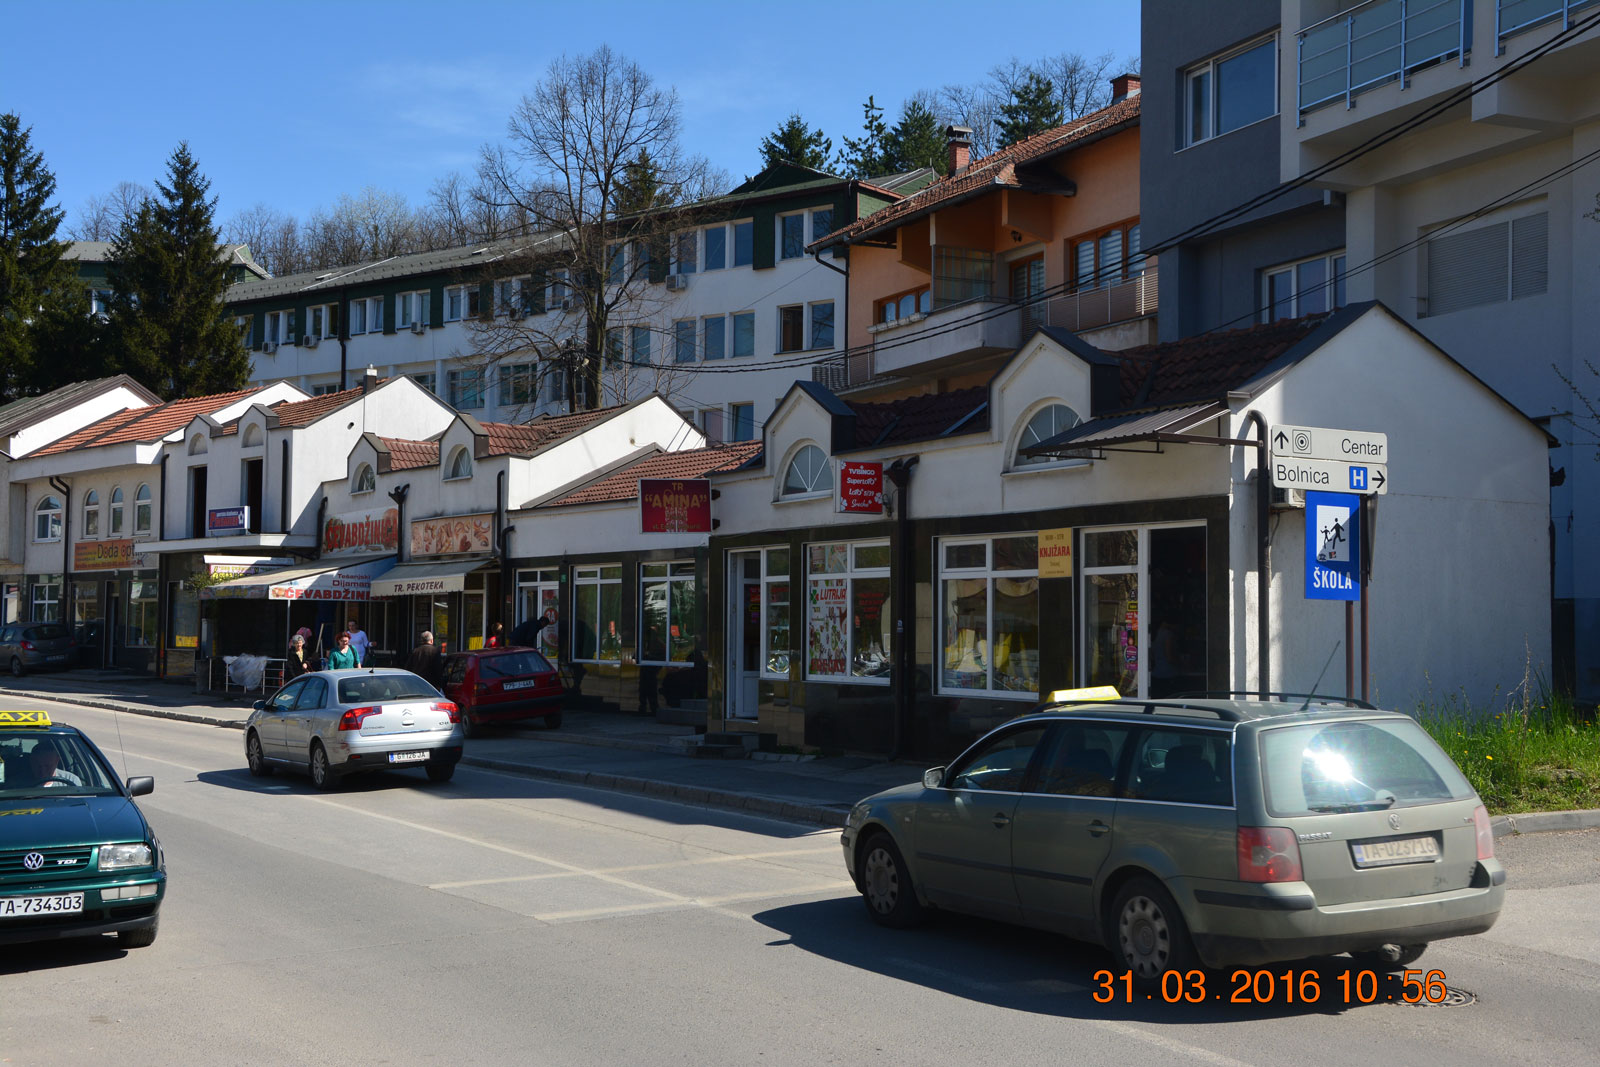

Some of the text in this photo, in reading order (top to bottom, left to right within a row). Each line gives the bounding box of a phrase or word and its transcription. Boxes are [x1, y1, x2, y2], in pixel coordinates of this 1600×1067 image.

[1341, 438, 1383, 456] Centar
[1277, 464, 1330, 485] Bolnica
[672, 482, 684, 491] TR
[1039, 544, 1070, 558] KNJIŽARA
[332, 579, 371, 588] Dijaman
[1313, 566, 1352, 589] ŠKOLA
[820, 588, 847, 600] LUTRIJA
[1299, 831, 1333, 842] PASSAT
